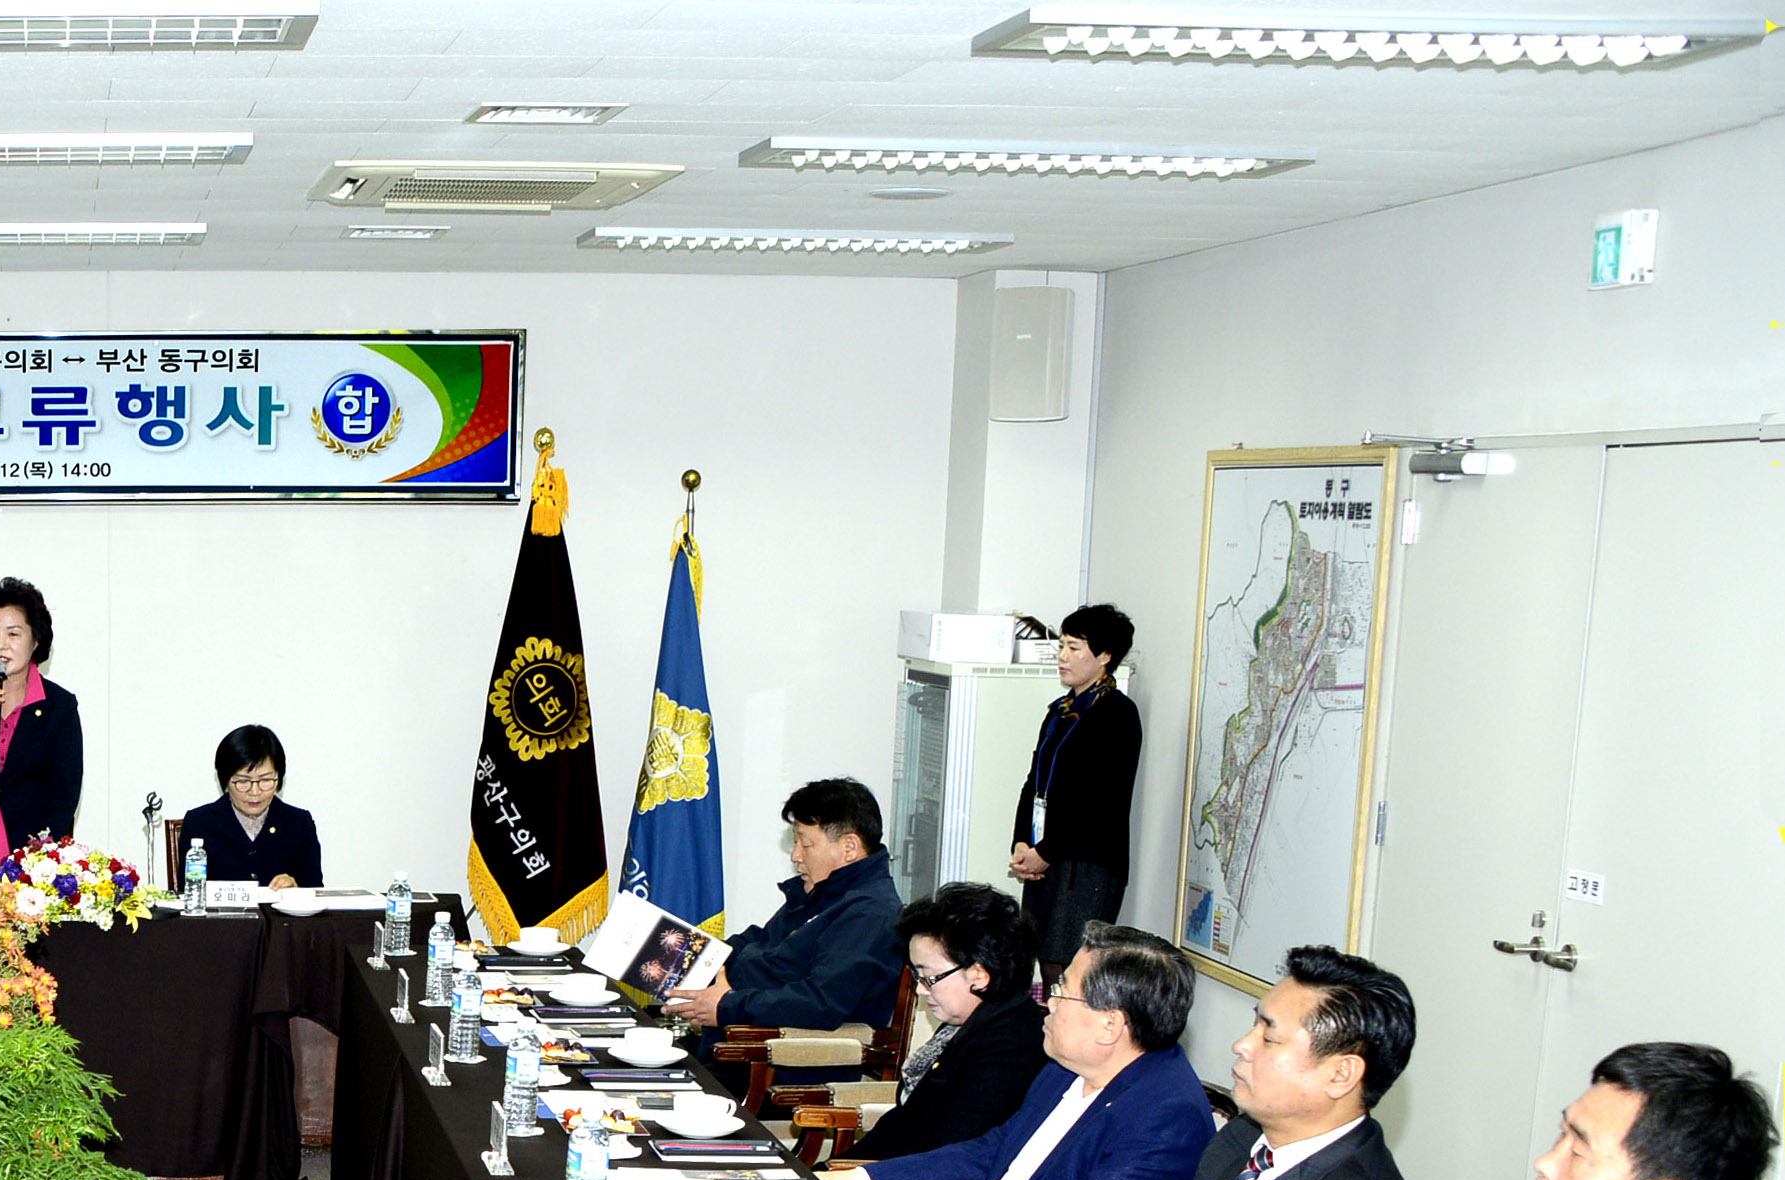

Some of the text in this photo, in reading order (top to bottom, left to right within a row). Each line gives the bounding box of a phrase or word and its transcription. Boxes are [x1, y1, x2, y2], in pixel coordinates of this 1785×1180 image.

[96, 348, 148, 373] 부산
[157, 348, 260, 373] 동구의회
[335, 384, 379, 435] 합
[0, 460, 54, 480] 12(목)
[61, 462, 111, 478] 14:00
[525, 673, 568, 727] 의회
[476, 754, 551, 879] 광산구의회
[1567, 875, 1599, 897] 고정문
